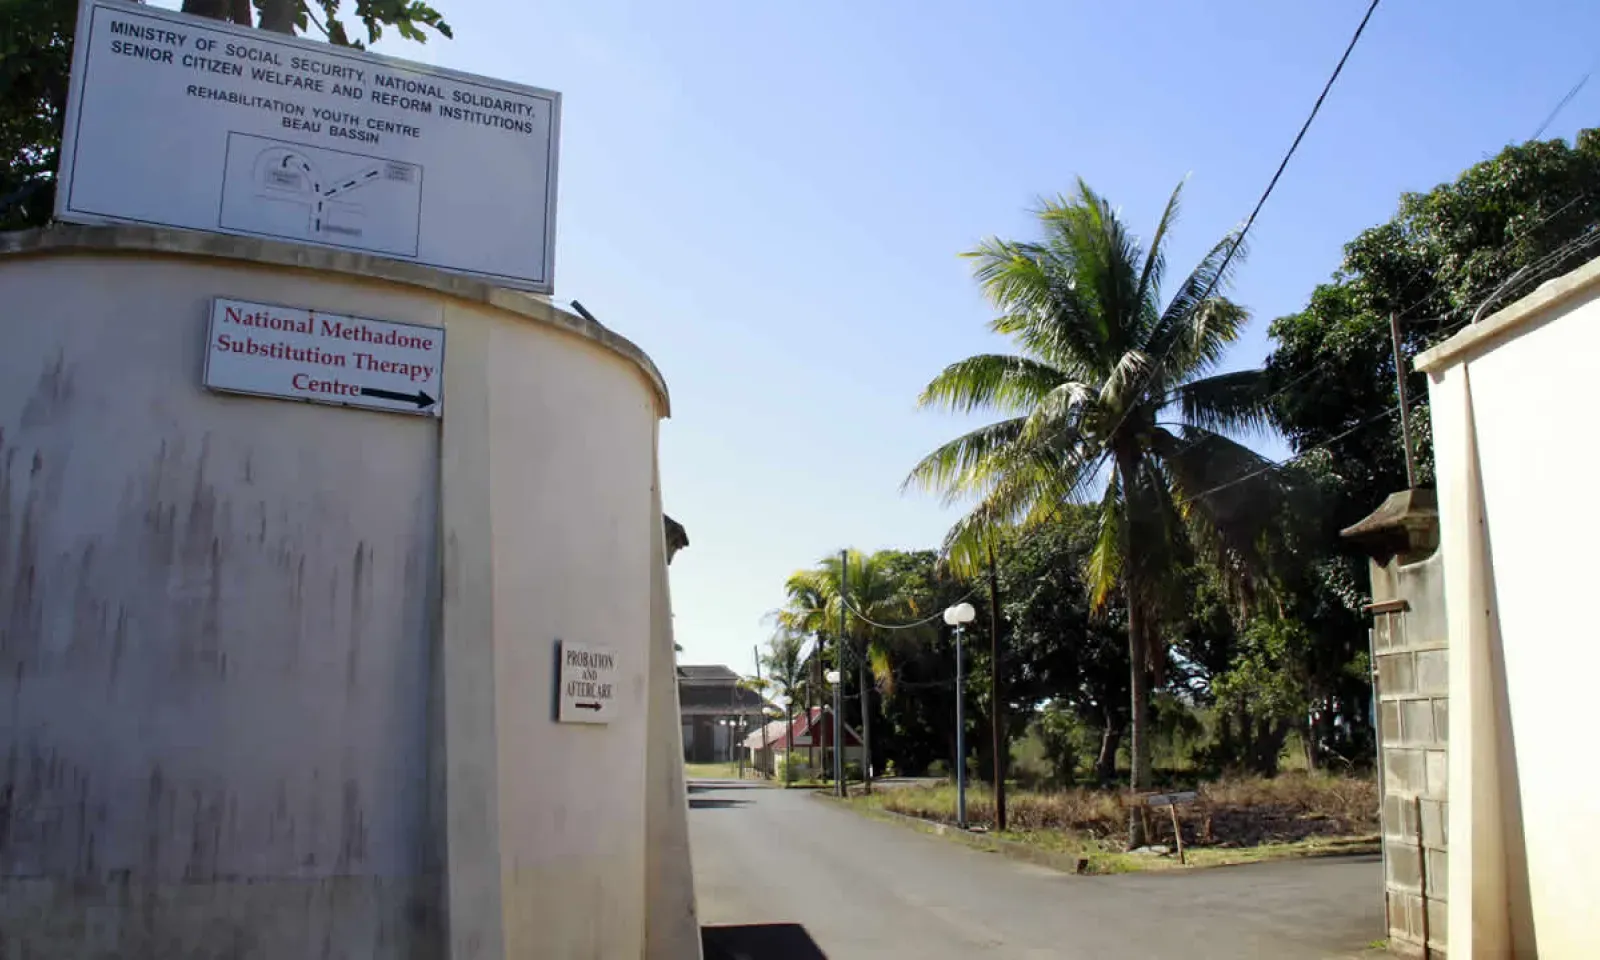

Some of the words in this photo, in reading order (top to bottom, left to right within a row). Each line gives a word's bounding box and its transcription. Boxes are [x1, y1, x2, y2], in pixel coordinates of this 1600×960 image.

[110, 20, 187, 47] MINISTRY
[195, 38, 218, 52] OF
[225, 43, 281, 66] SOCIAL
[291, 57, 366, 84] SECURITY,
[375, 74, 445, 100] NATIONAL
[453, 90, 535, 118] SOLIDARITY,
[111, 40, 174, 64] SENIOR
[182, 54, 243, 77] CITIZEN
[251, 67, 324, 92] WELFARE
[332, 84, 363, 100] AND
[372, 90, 432, 113] REFORM
[439, 105, 532, 134] INSTITUTIONS
[187, 84, 305, 116] REHABILITATION
[313, 107, 359, 126] YOUTH
[366, 118, 420, 138] CENTRE
[282, 116, 321, 134] BEAU
[329, 127, 379, 145] BASSIN
[223, 306, 315, 334] National
[320, 319, 433, 350] Methadone
[216, 334, 346, 367] Substitution
[352, 351, 434, 382] Therapy
[292, 373, 361, 397] Centre
[566, 650, 614, 669] PROBATION
[582, 670, 598, 681] AND
[566, 682, 612, 700] AFTERCARE
